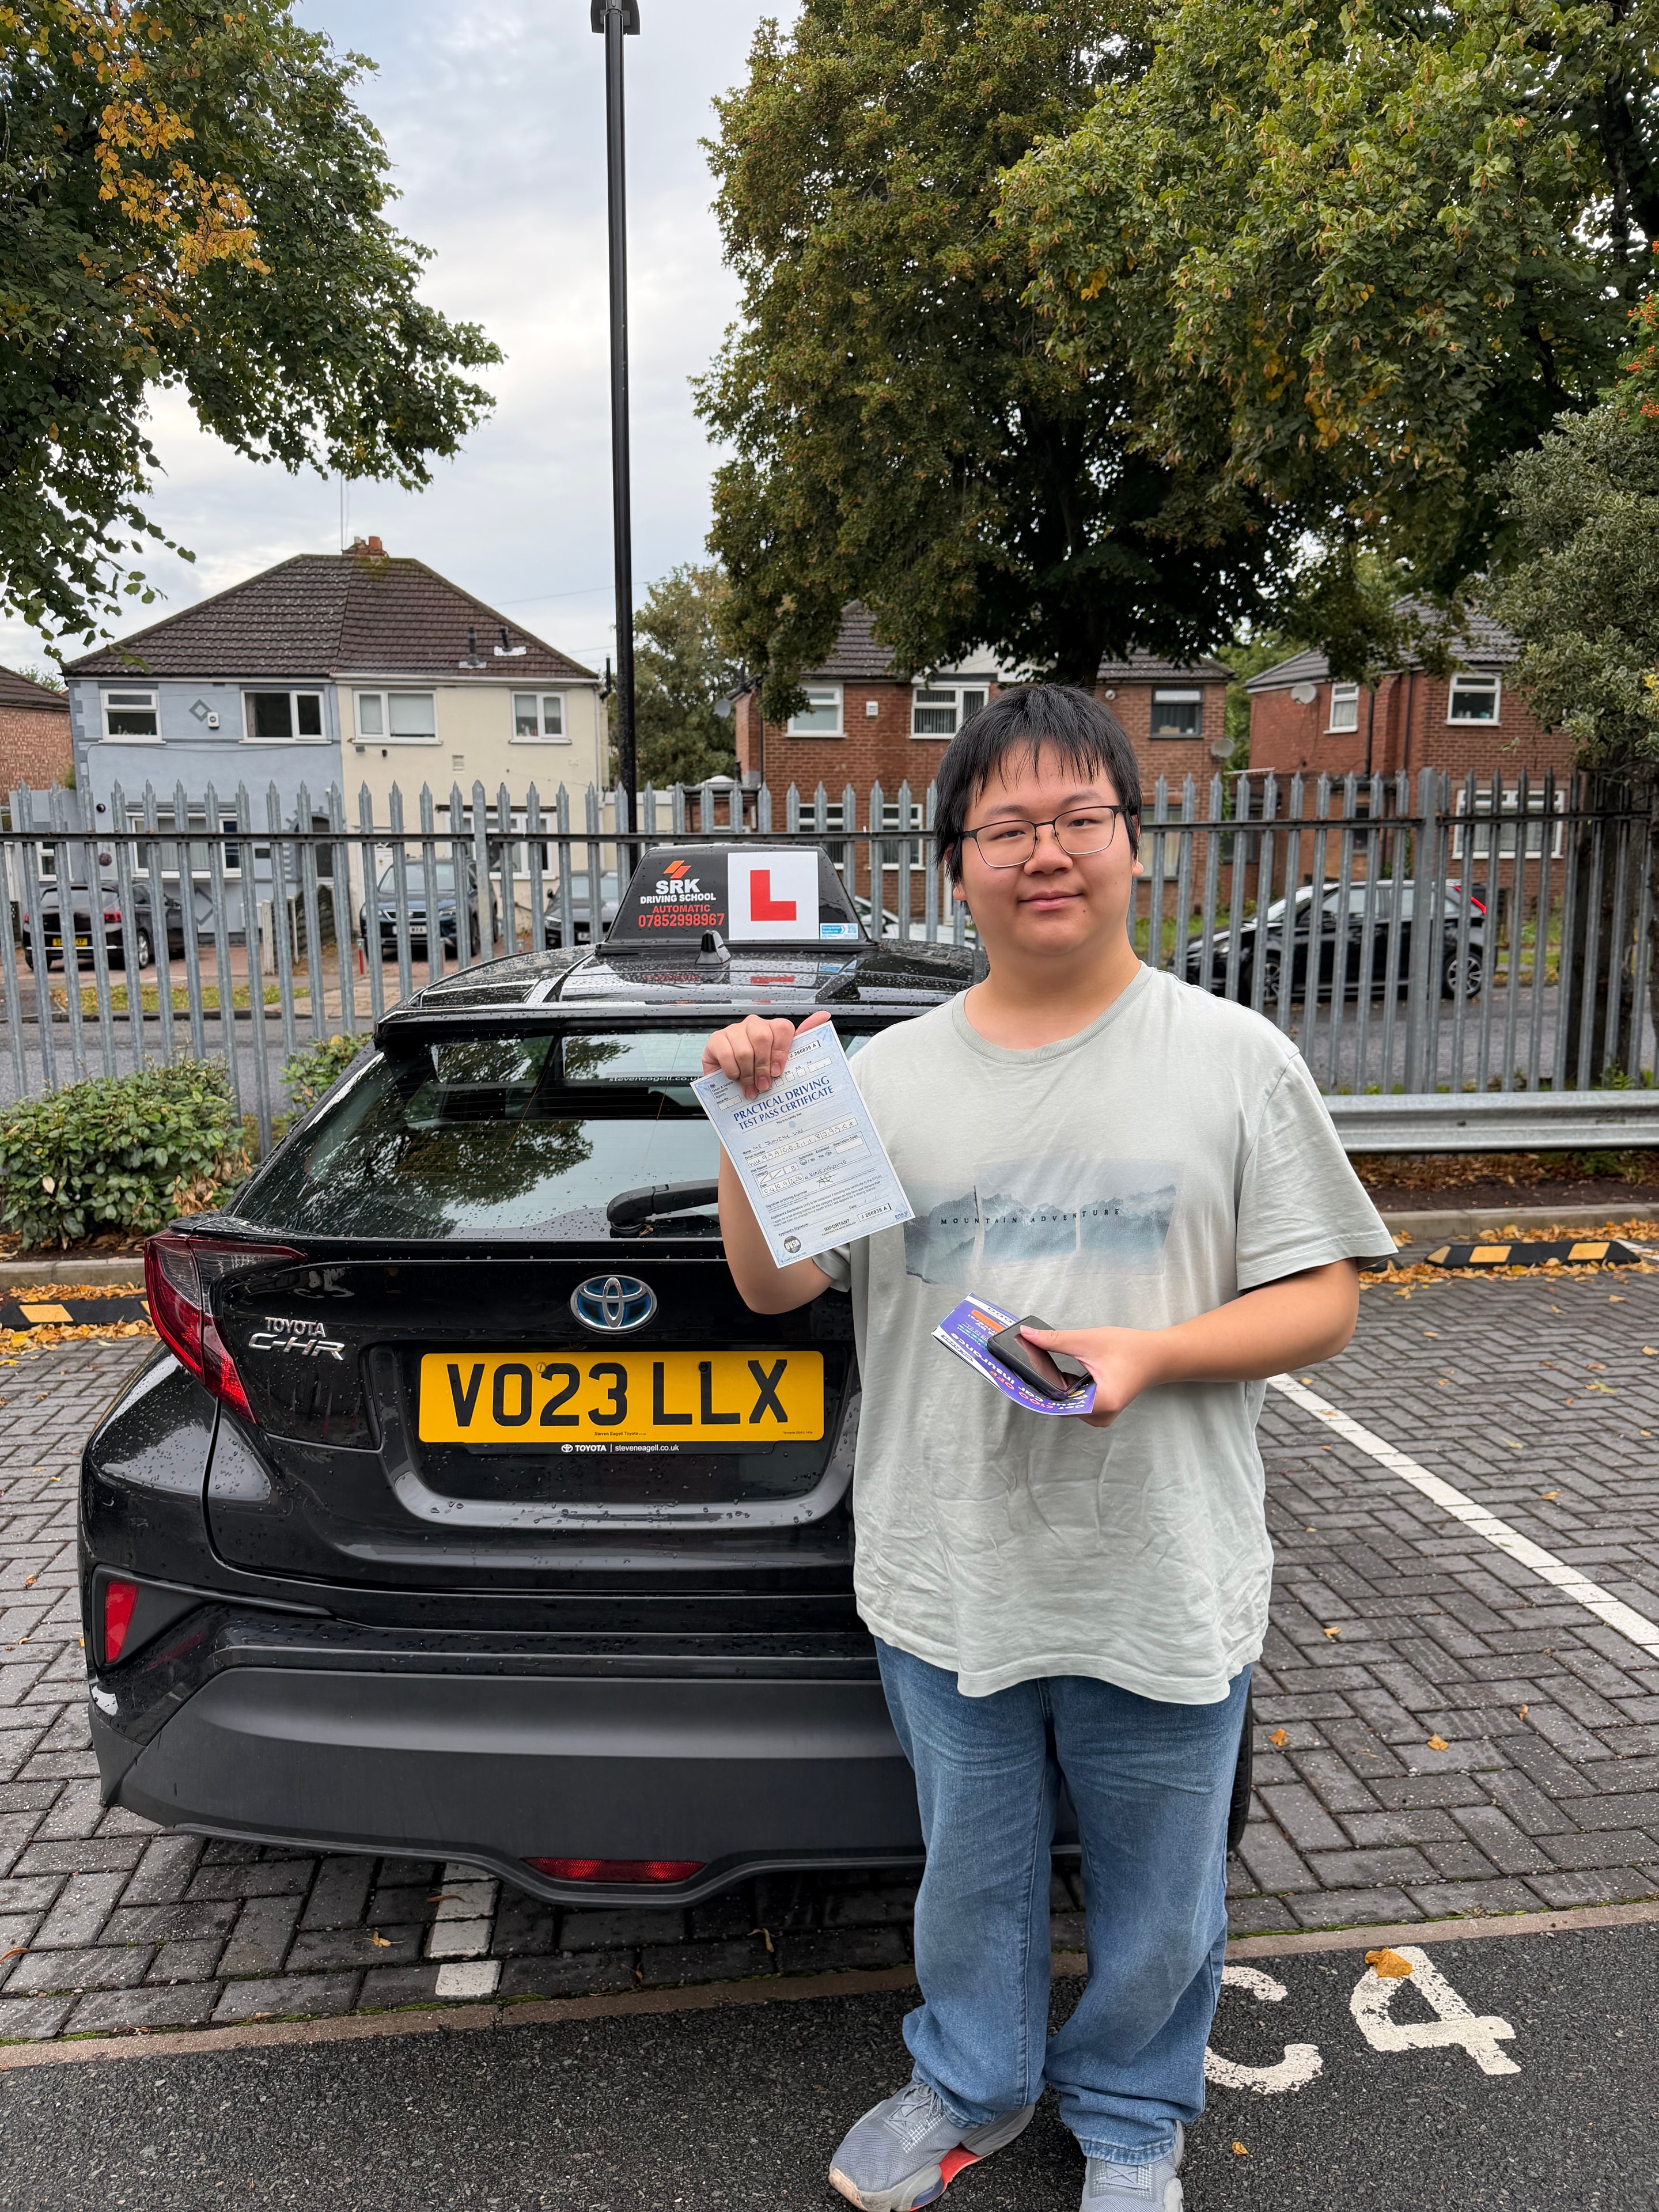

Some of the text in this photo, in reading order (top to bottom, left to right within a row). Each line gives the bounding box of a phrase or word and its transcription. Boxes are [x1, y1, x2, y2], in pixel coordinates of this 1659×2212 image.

[656, 878, 700, 895] SRK
[640, 892, 717, 904] DRIVING SCHOOL
[750, 869, 797, 922] L
[652, 904, 711, 914] AUTOMATIC
[638, 912, 725, 928] 07852998967
[732, 1074, 830, 1122] PRACTICAL DRIVING
[737, 1084, 835, 1131] TEST PASS CERTIFICATE
[823, 1218, 851, 1232] IMPORTANT
[941, 1208, 1120, 1225] MOUNTAIN ADVENTURE
[783, 1237, 801, 1250] DVSA
[265, 1316, 326, 1338] TOYOTA
[248, 1332, 345, 1361] C-HR
[990, 1370, 1016, 1391] OFF
[448, 1359, 789, 1427] VO23 LLX
[1018, 1385, 1044, 1403] car
[575, 1444, 679, 1453] TOYOTA steveneagell.co.uk
